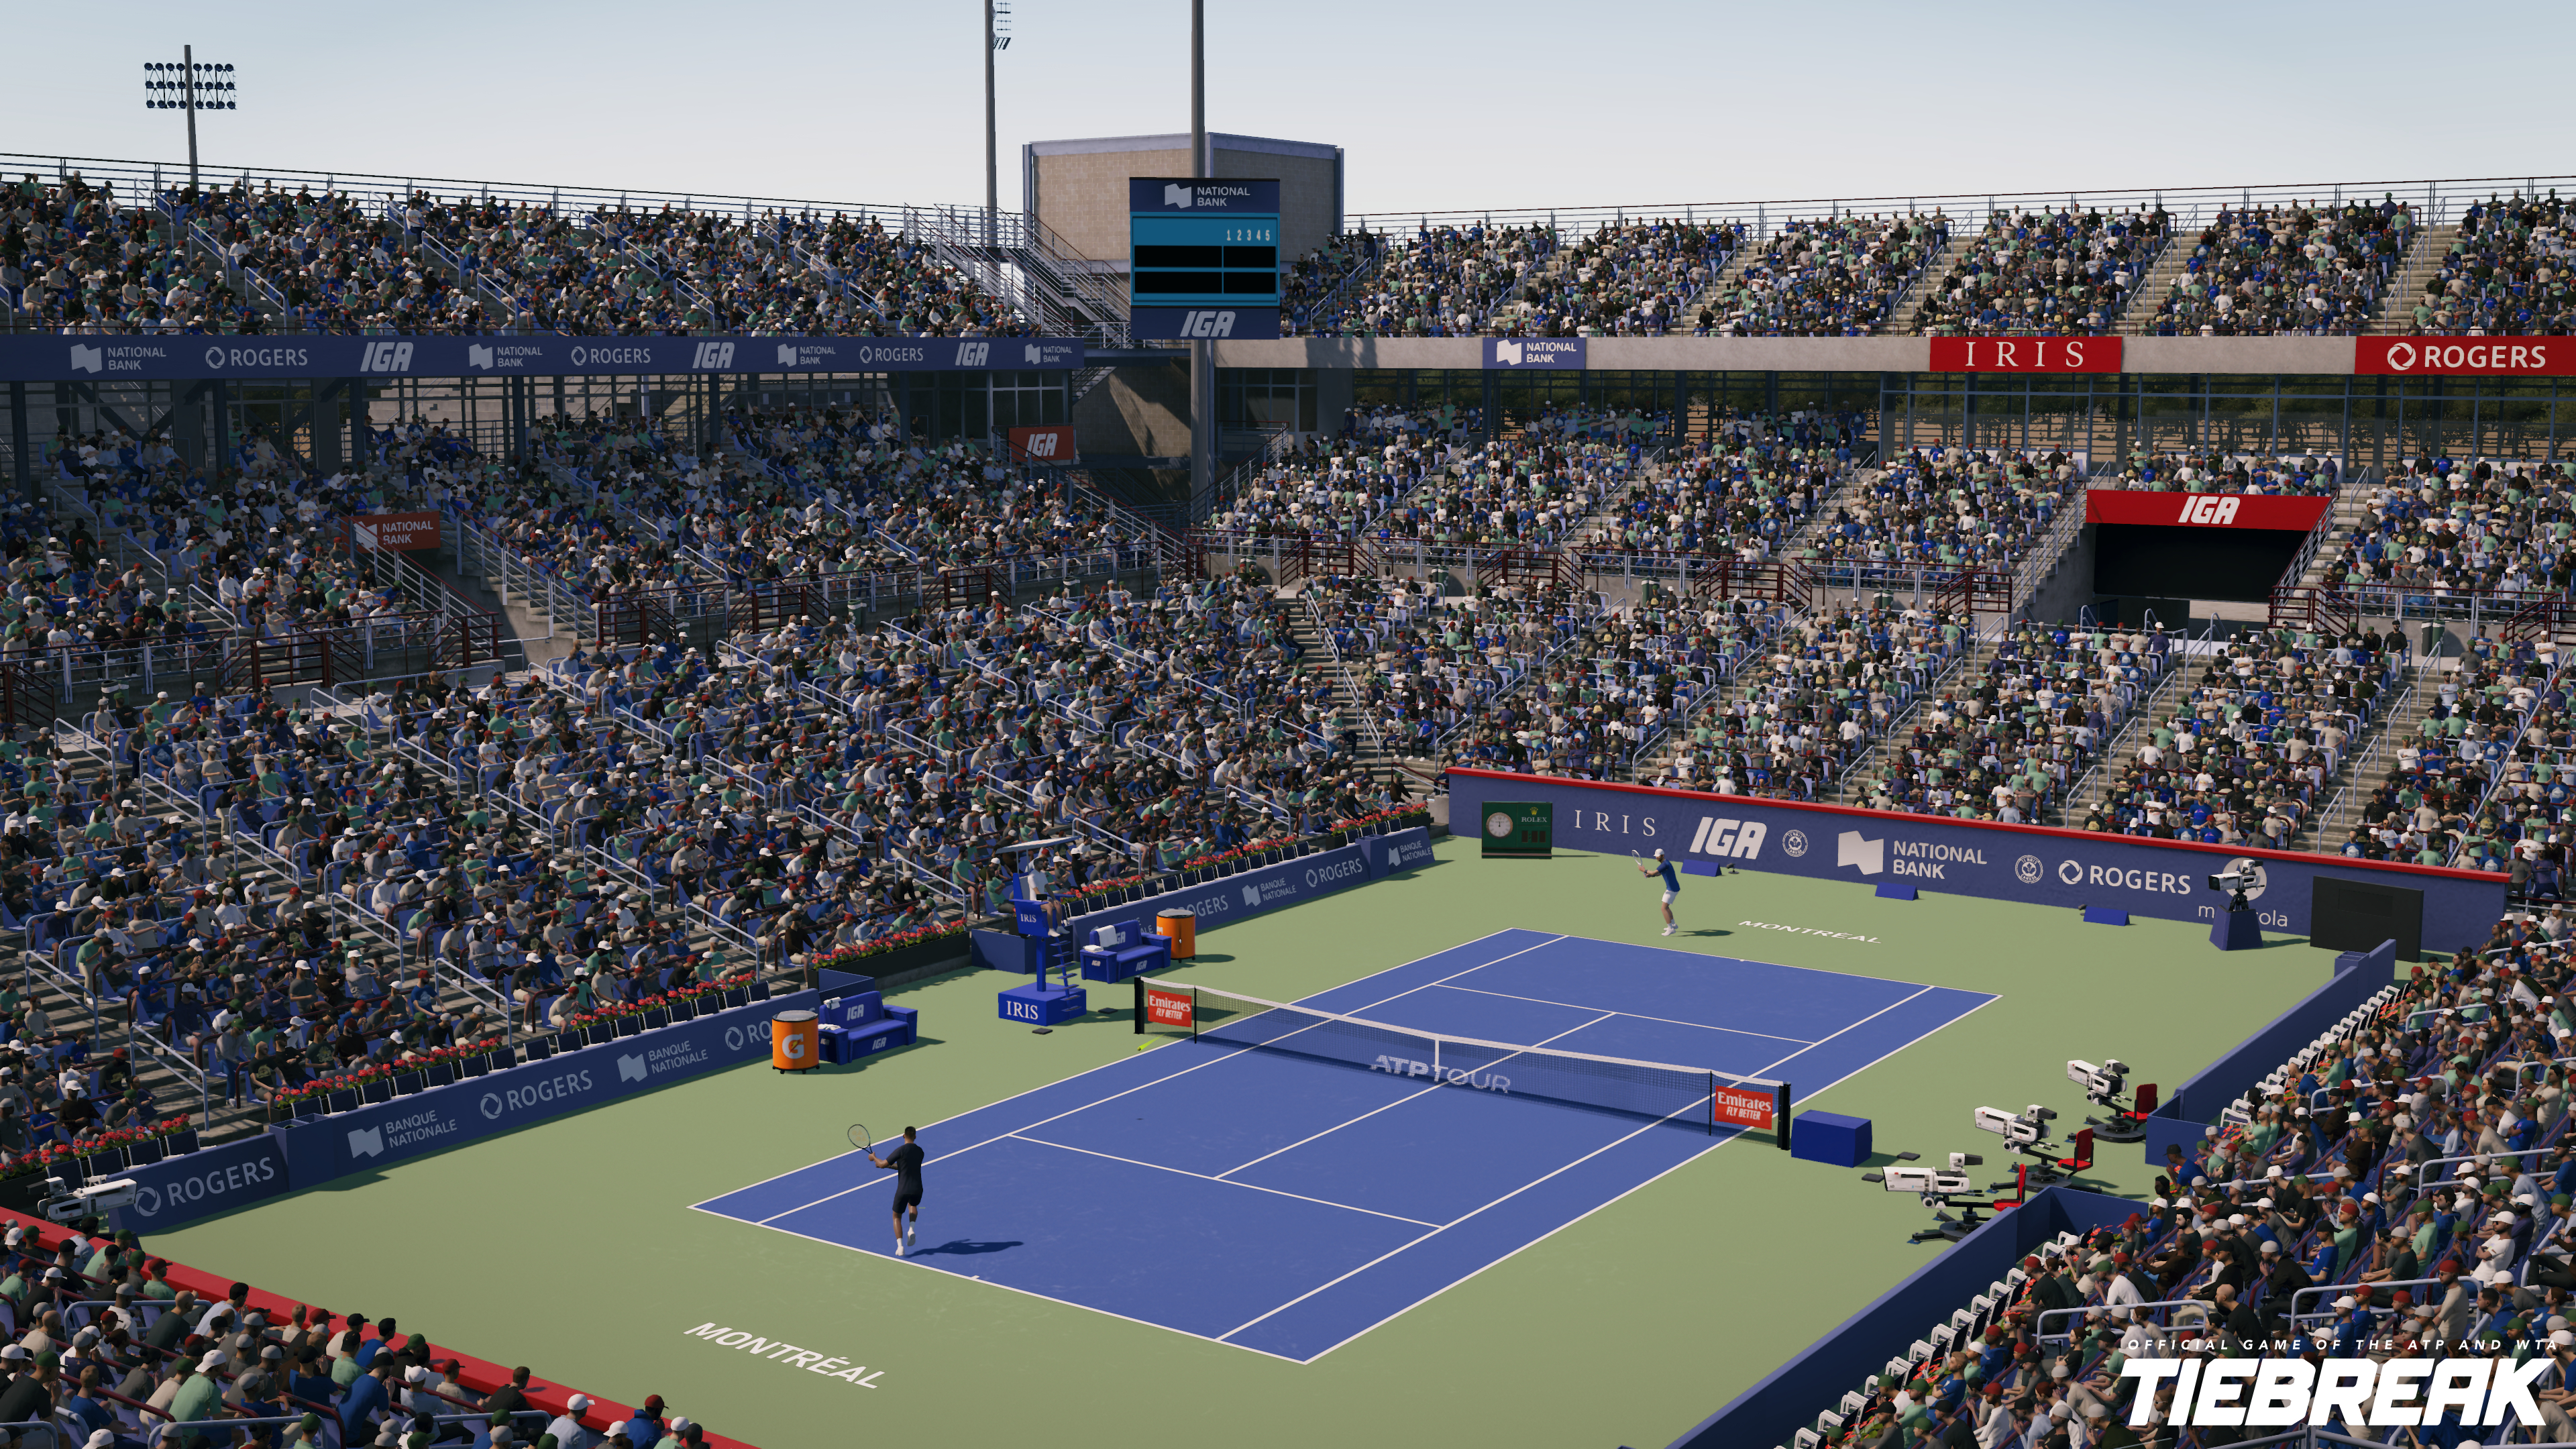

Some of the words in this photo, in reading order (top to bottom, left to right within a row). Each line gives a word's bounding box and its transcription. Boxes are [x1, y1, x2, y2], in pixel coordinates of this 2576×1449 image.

[1197, 186, 1250, 196] NATIONAL
[1197, 197, 1227, 207] BANK
[1226, 229, 1231, 241] 1
[1237, 229, 1242, 241] 2
[1246, 229, 1251, 241] 3
[1256, 229, 1261, 241] 4
[1265, 229, 1270, 241] 5
[1179, 311, 1236, 337] IGA
[107, 346, 166, 359] NATIONAL
[497, 346, 543, 357] NATIONAL
[590, 347, 651, 364] ROGERS
[692, 342, 734, 368] IGA
[800, 345, 836, 356] NATIONAL
[873, 347, 924, 362] ROGERS
[955, 342, 989, 366] IGA
[1042, 345, 1073, 355] NATIONAL
[1527, 342, 1576, 352] NATIONAL
[1965, 341, 2084, 367] IRIS
[108, 360, 142, 370] BANK
[231, 349, 308, 367] ROGERS
[360, 342, 414, 372] IGA
[497, 357, 523, 367] BANK
[800, 355, 821, 364] BANK
[1042, 354, 1061, 364] BANK
[1527, 354, 1554, 363] BANK
[2424, 345, 2546, 369] ROGERS
[1025, 433, 1058, 457] IGA
[2178, 496, 2240, 525] IGA
[382, 521, 433, 532] NATIONAL
[383, 533, 412, 545] BANK
[1574, 809, 1656, 837] IRIS
[1399, 840, 1422, 853] BANQUE
[1689, 816, 1767, 860] IGA
[1402, 847, 1432, 862] NATIONALE
[1893, 840, 1987, 865] NATIONAL
[1319, 857, 1363, 883] ROGERS
[1893, 859, 1945, 879] BANK
[1260, 877, 1286, 892] BANQUE
[2090, 865, 2191, 895] ROGERS
[1263, 884, 1297, 902] NATIONALE
[1178, 894, 1228, 917] OGERS
[1020, 913, 1036, 923] IRIS
[2198, 906, 2288, 927] mola
[1116, 931, 1126, 944] GA
[1737, 920, 1882, 944] MONTRÉAL
[1136, 960, 1148, 971] IGA
[847, 1004, 864, 1021] IGA
[1006, 1000, 1038, 1020] IRIS
[1149, 995, 1191, 1012] Emirates
[1156, 1008, 1165, 1017] FLY
[1165, 1009, 1183, 1020] BETTER
[648, 1040, 692, 1062] BANQUE
[782, 1033, 804, 1059] G
[872, 1036, 887, 1051] IGA
[651, 1049, 708, 1075] NATIONALE
[1369, 1055, 1429, 1077] ATP
[1431, 1063, 1511, 1093] TOUR
[508, 1069, 593, 1112] ROGERS
[1717, 1091, 1772, 1112] Emirates
[1726, 1106, 1738, 1117] FLY
[1738, 1108, 1761, 1121] BETTER
[385, 1110, 439, 1136] BANQUE
[388, 1118, 458, 1150] NATIONALE
[168, 1157, 274, 1207] ROGERS
[683, 1322, 885, 1389] MONTRÉAL
